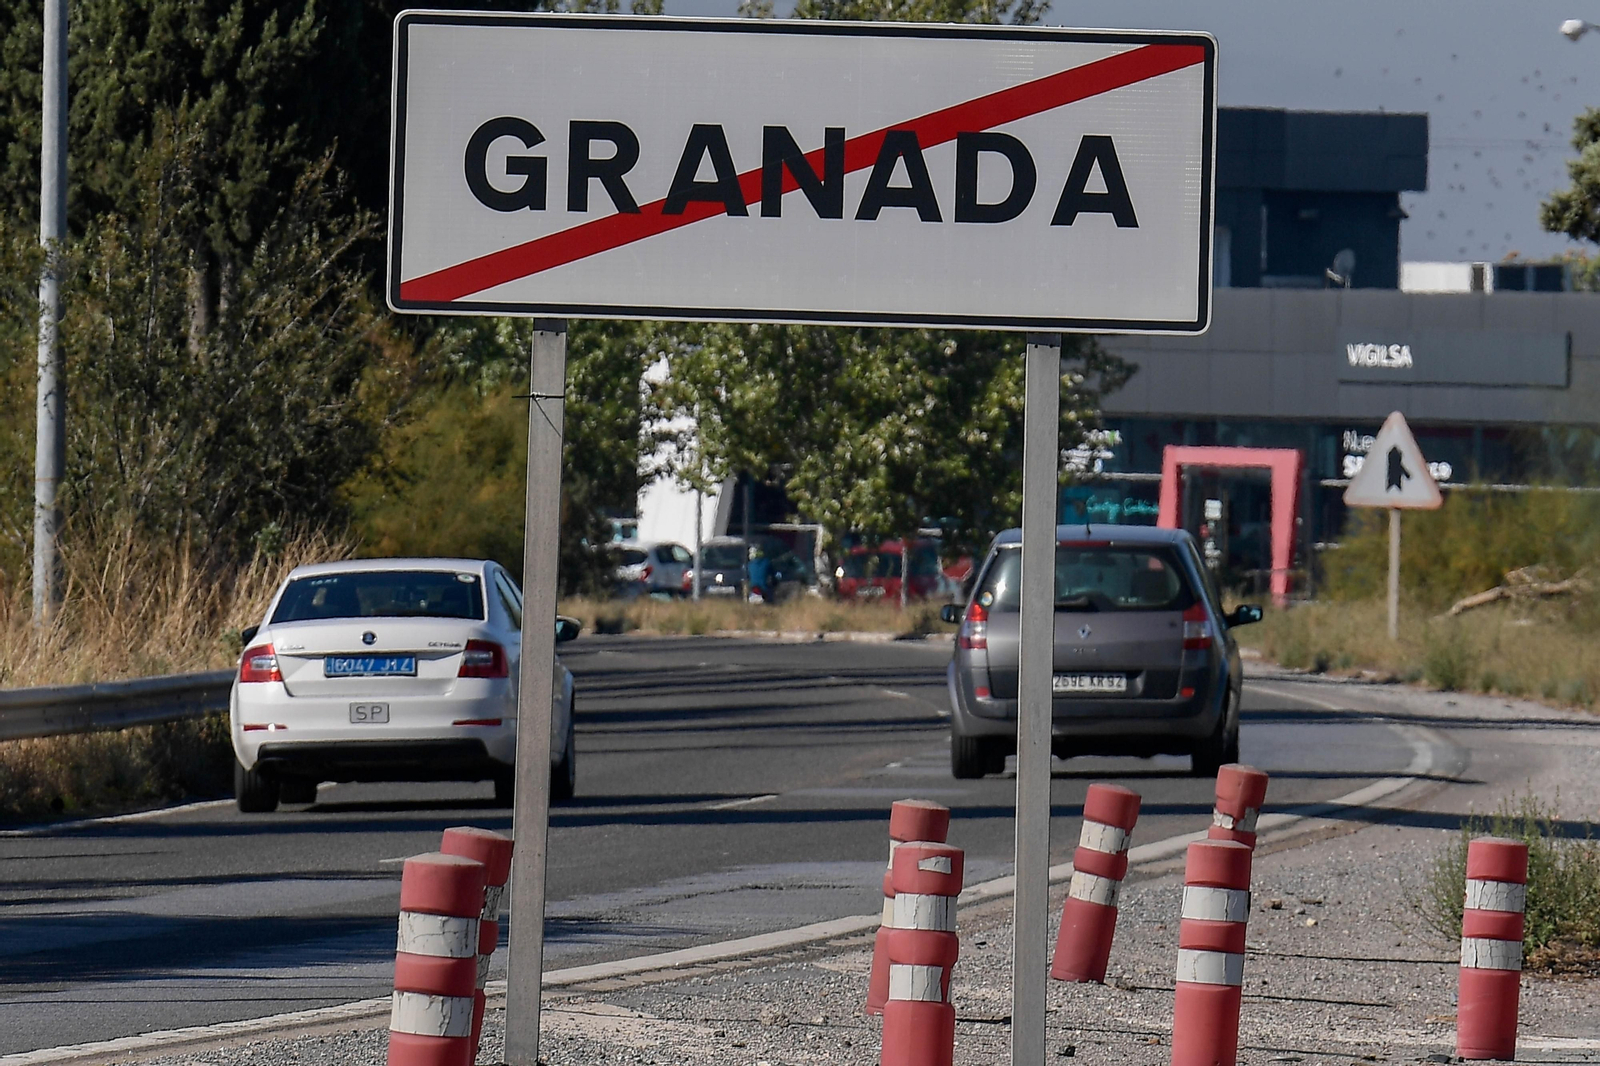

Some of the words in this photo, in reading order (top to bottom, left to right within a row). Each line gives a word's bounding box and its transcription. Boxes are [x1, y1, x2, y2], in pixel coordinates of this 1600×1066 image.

[463, 116, 1139, 229] GRANADA
[1346, 342, 1413, 368] VIGILSA
[334, 658, 375, 672] 6047
[355, 705, 383, 720] SP
